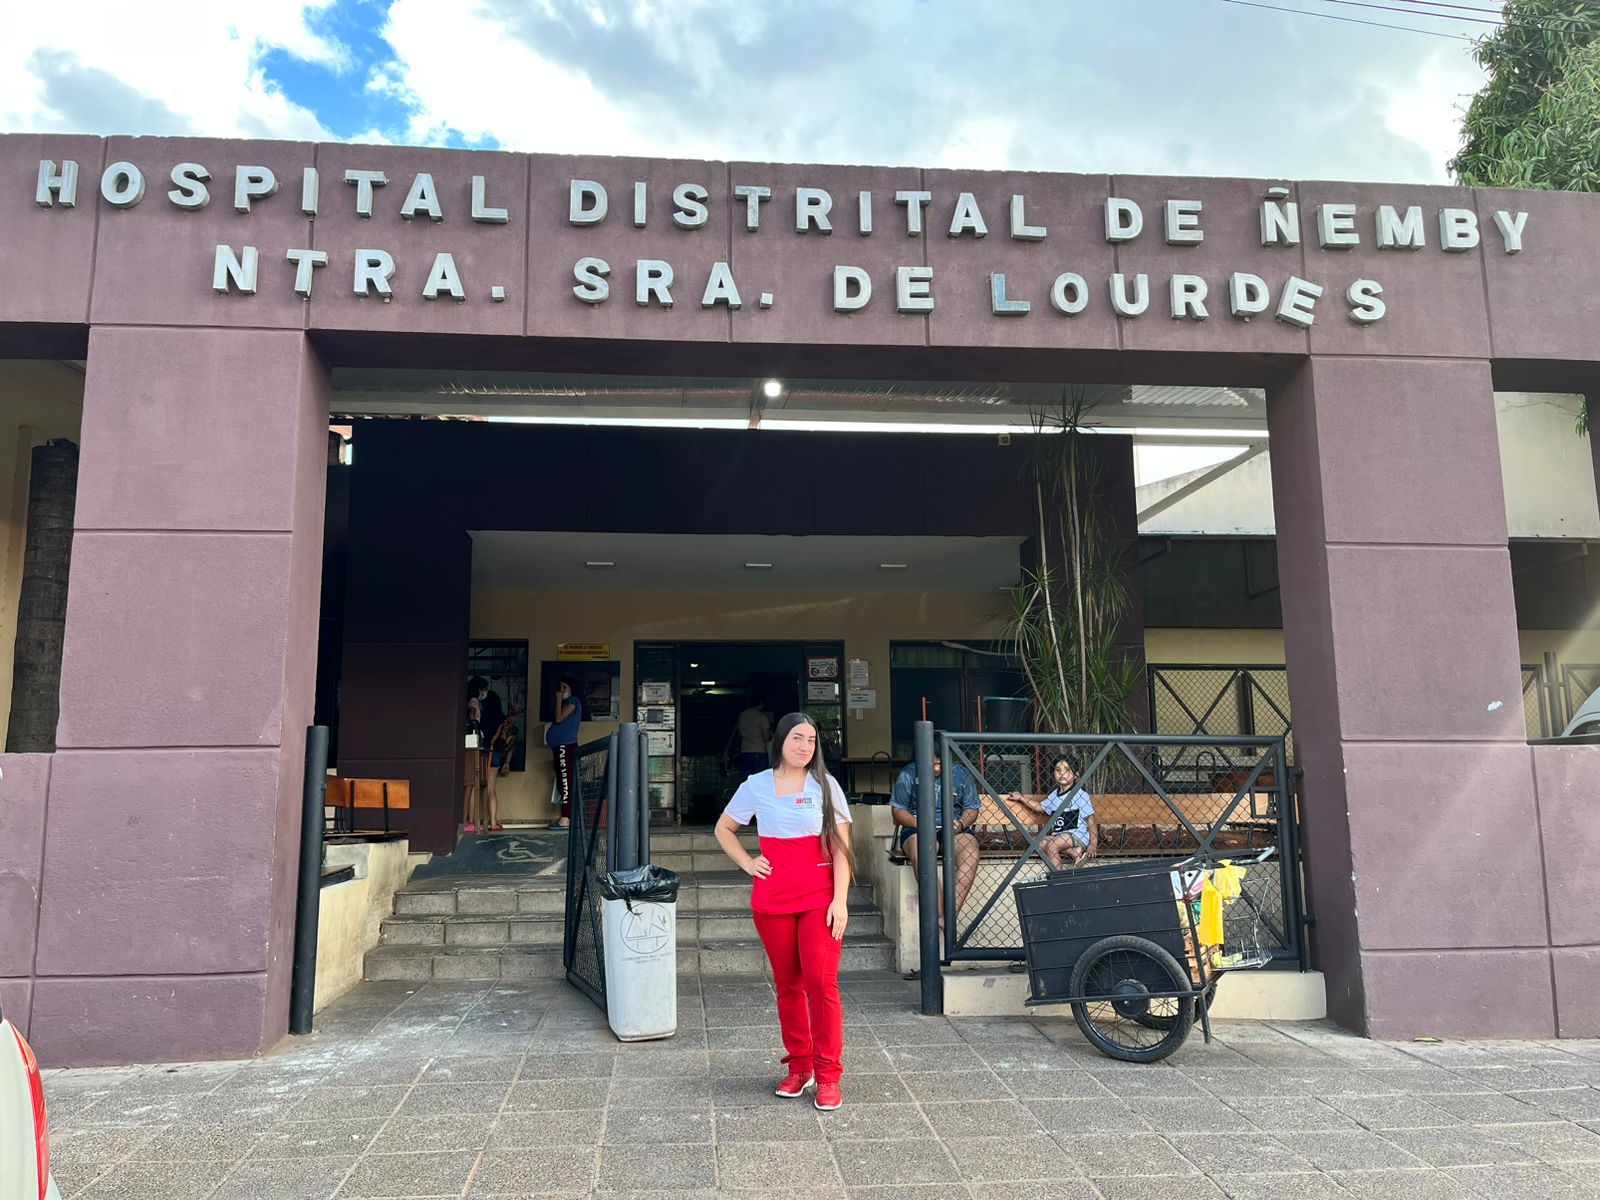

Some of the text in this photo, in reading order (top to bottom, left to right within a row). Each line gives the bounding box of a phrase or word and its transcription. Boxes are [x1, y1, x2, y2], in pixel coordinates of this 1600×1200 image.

[36, 159, 1529, 255] HOSPITAL DISTRITAL DE ÑEMBY
[212, 244, 1387, 328] NTRA. SRA. DE LOURDES
